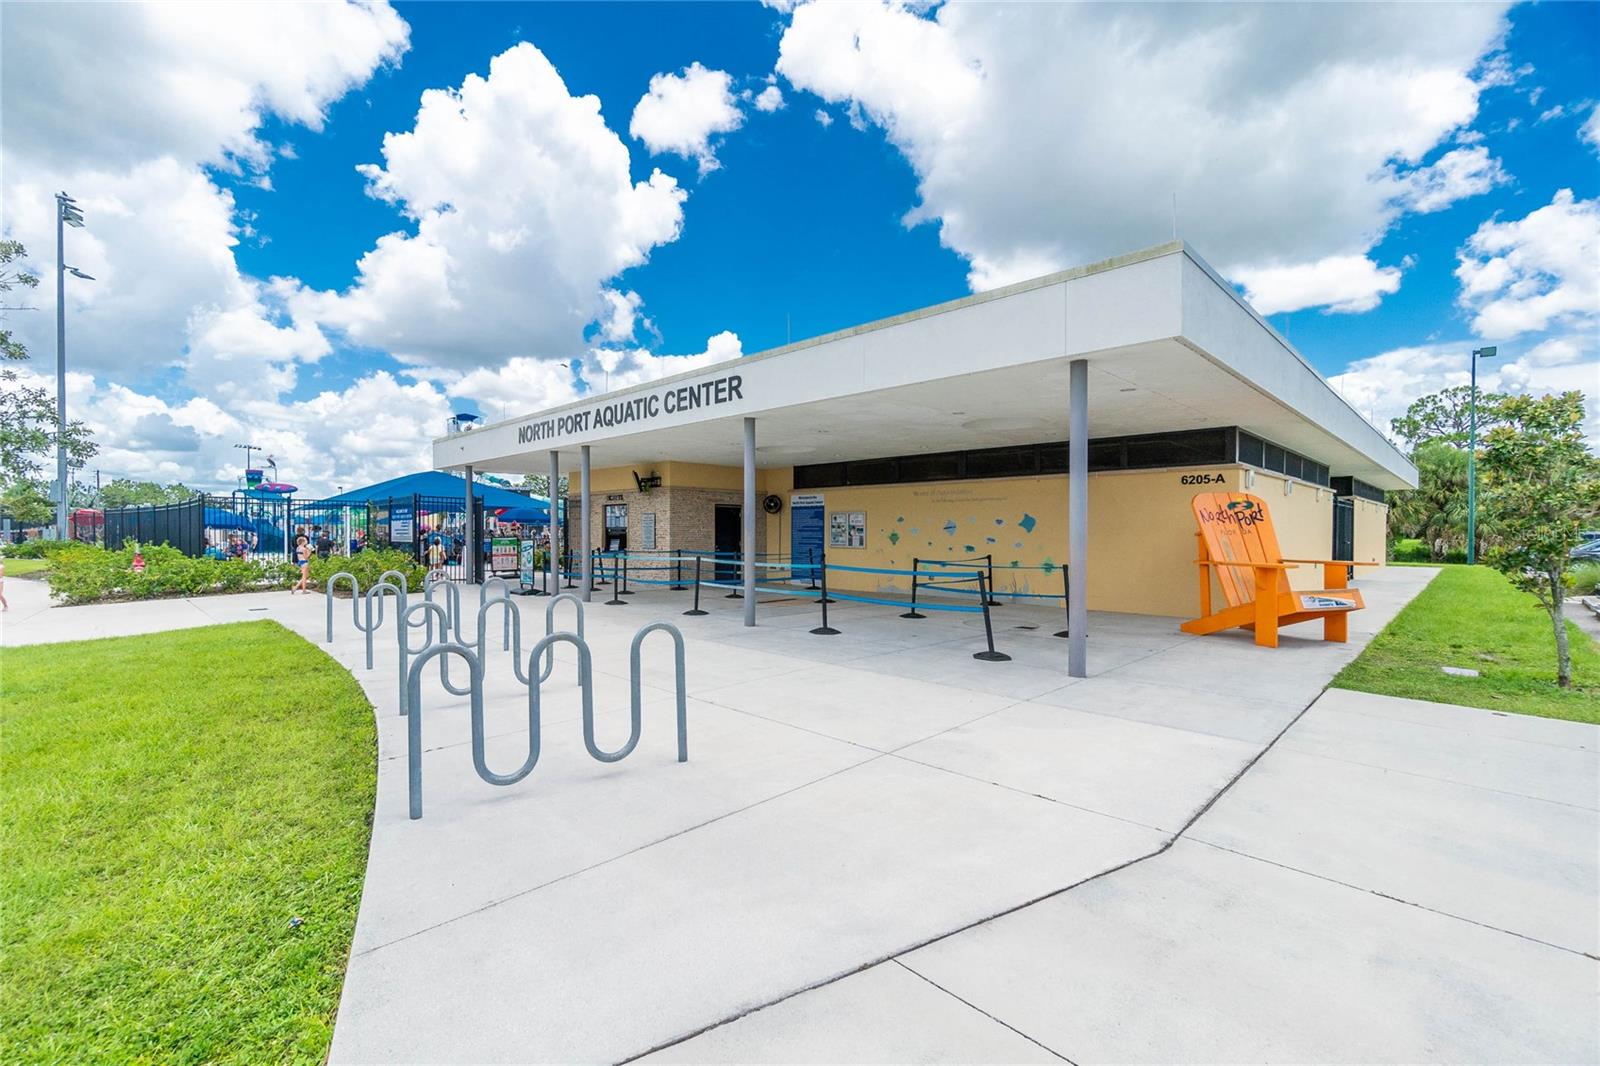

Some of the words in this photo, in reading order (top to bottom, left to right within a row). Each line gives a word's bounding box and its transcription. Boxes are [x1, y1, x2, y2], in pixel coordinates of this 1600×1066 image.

[518, 419, 555, 444] NORTH
[557, 410, 591, 436] PORT
[593, 394, 659, 429] AQUATIC
[663, 375, 743, 414] CENTER
[1180, 473, 1226, 485] 6205-A
